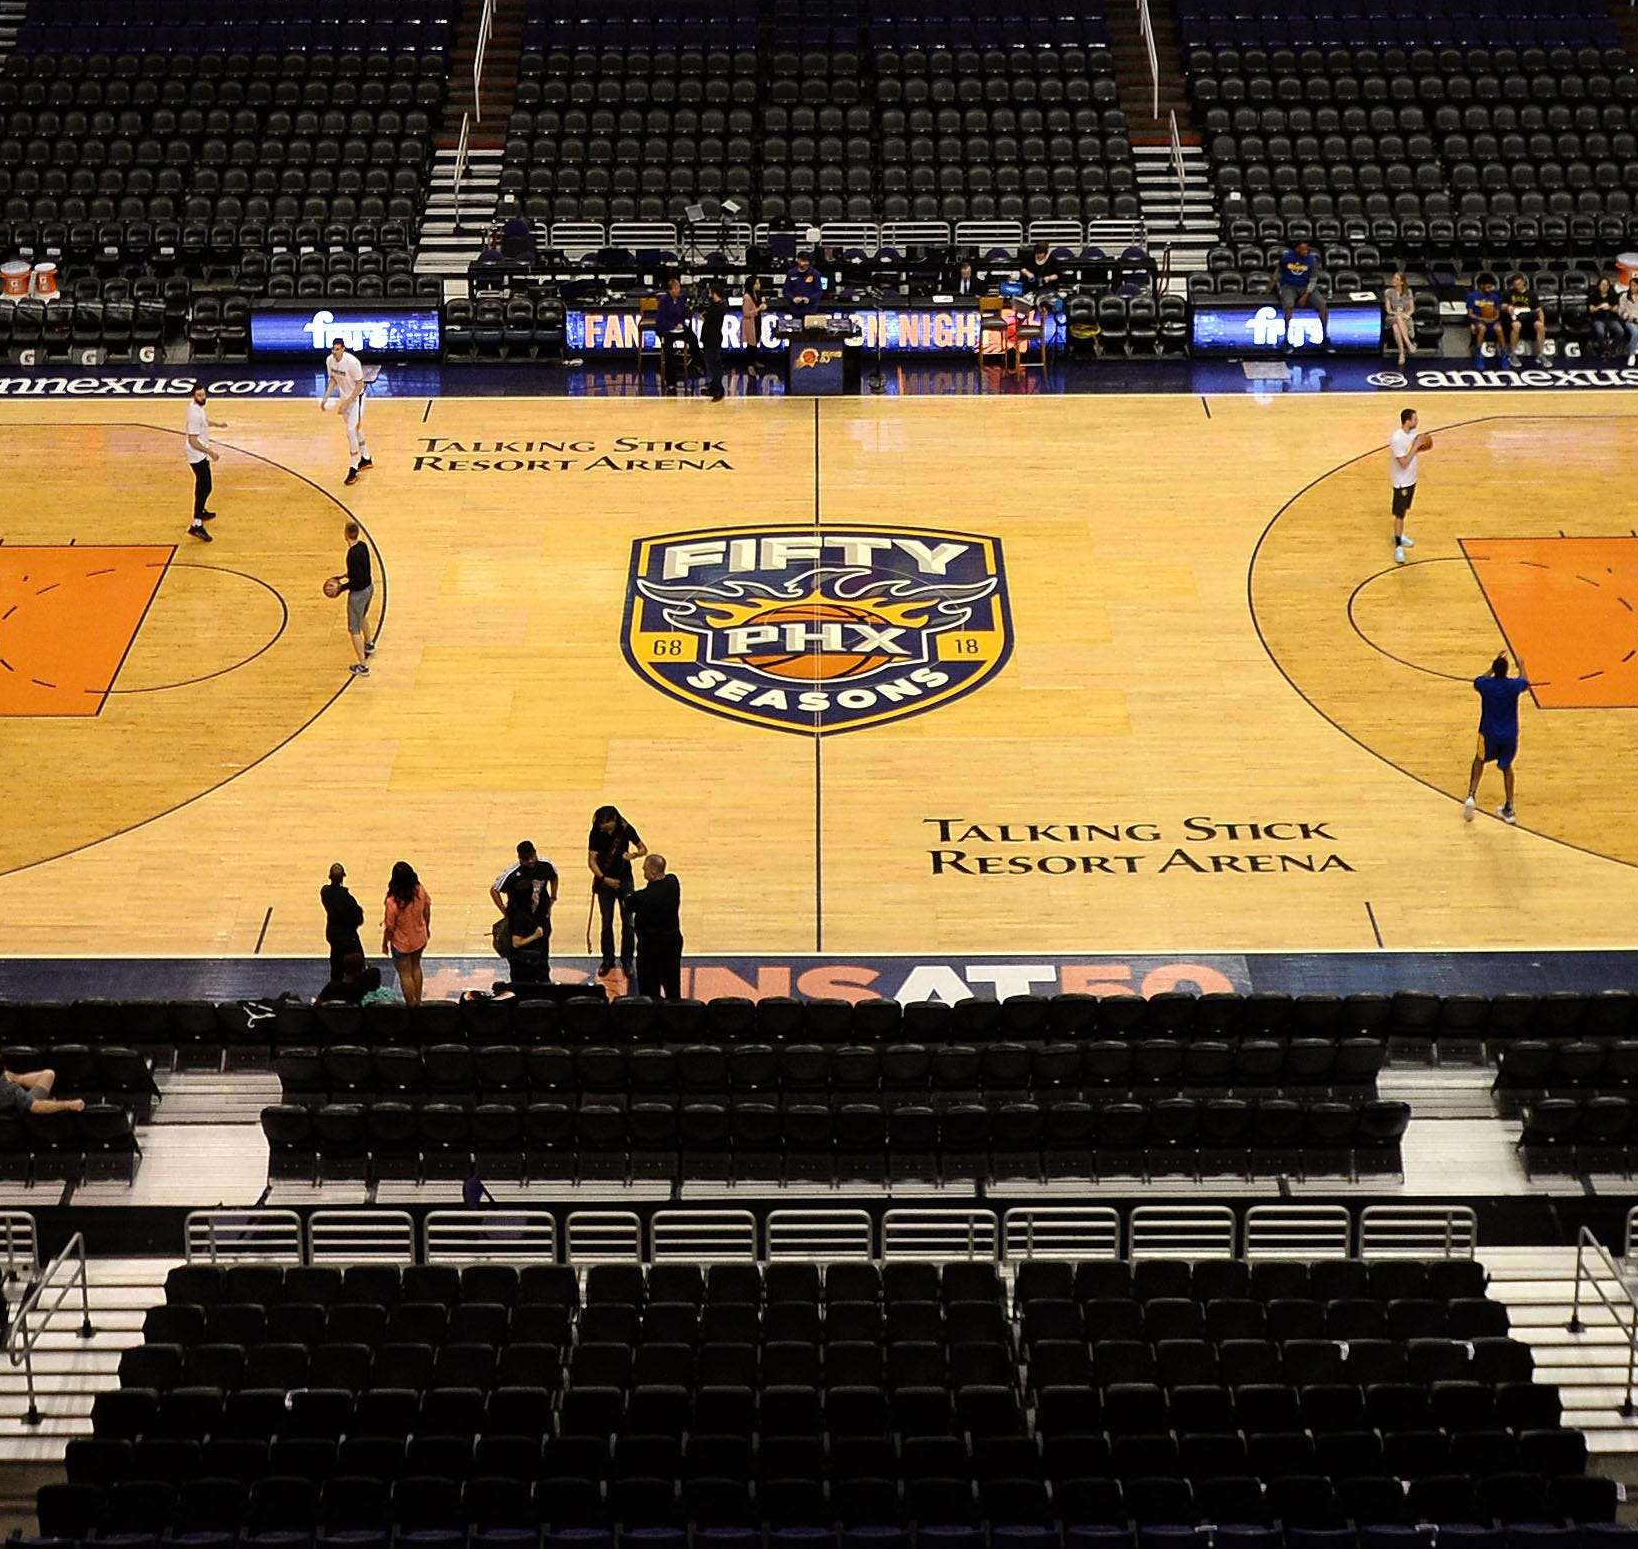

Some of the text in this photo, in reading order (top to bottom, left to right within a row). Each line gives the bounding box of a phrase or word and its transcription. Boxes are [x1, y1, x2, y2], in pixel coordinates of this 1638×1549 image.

[418, 436, 729, 453] TALKING STICK
[413, 455, 735, 471] RESORT ARENA
[663, 536, 969, 581] FIFTY
[726, 623, 912, 656] PHX
[956, 637, 979, 655] 18
[686, 668, 949, 712] SEASONS
[923, 816, 1338, 843] TALKING STICK
[931, 848, 1358, 876] RESORT ARENA
